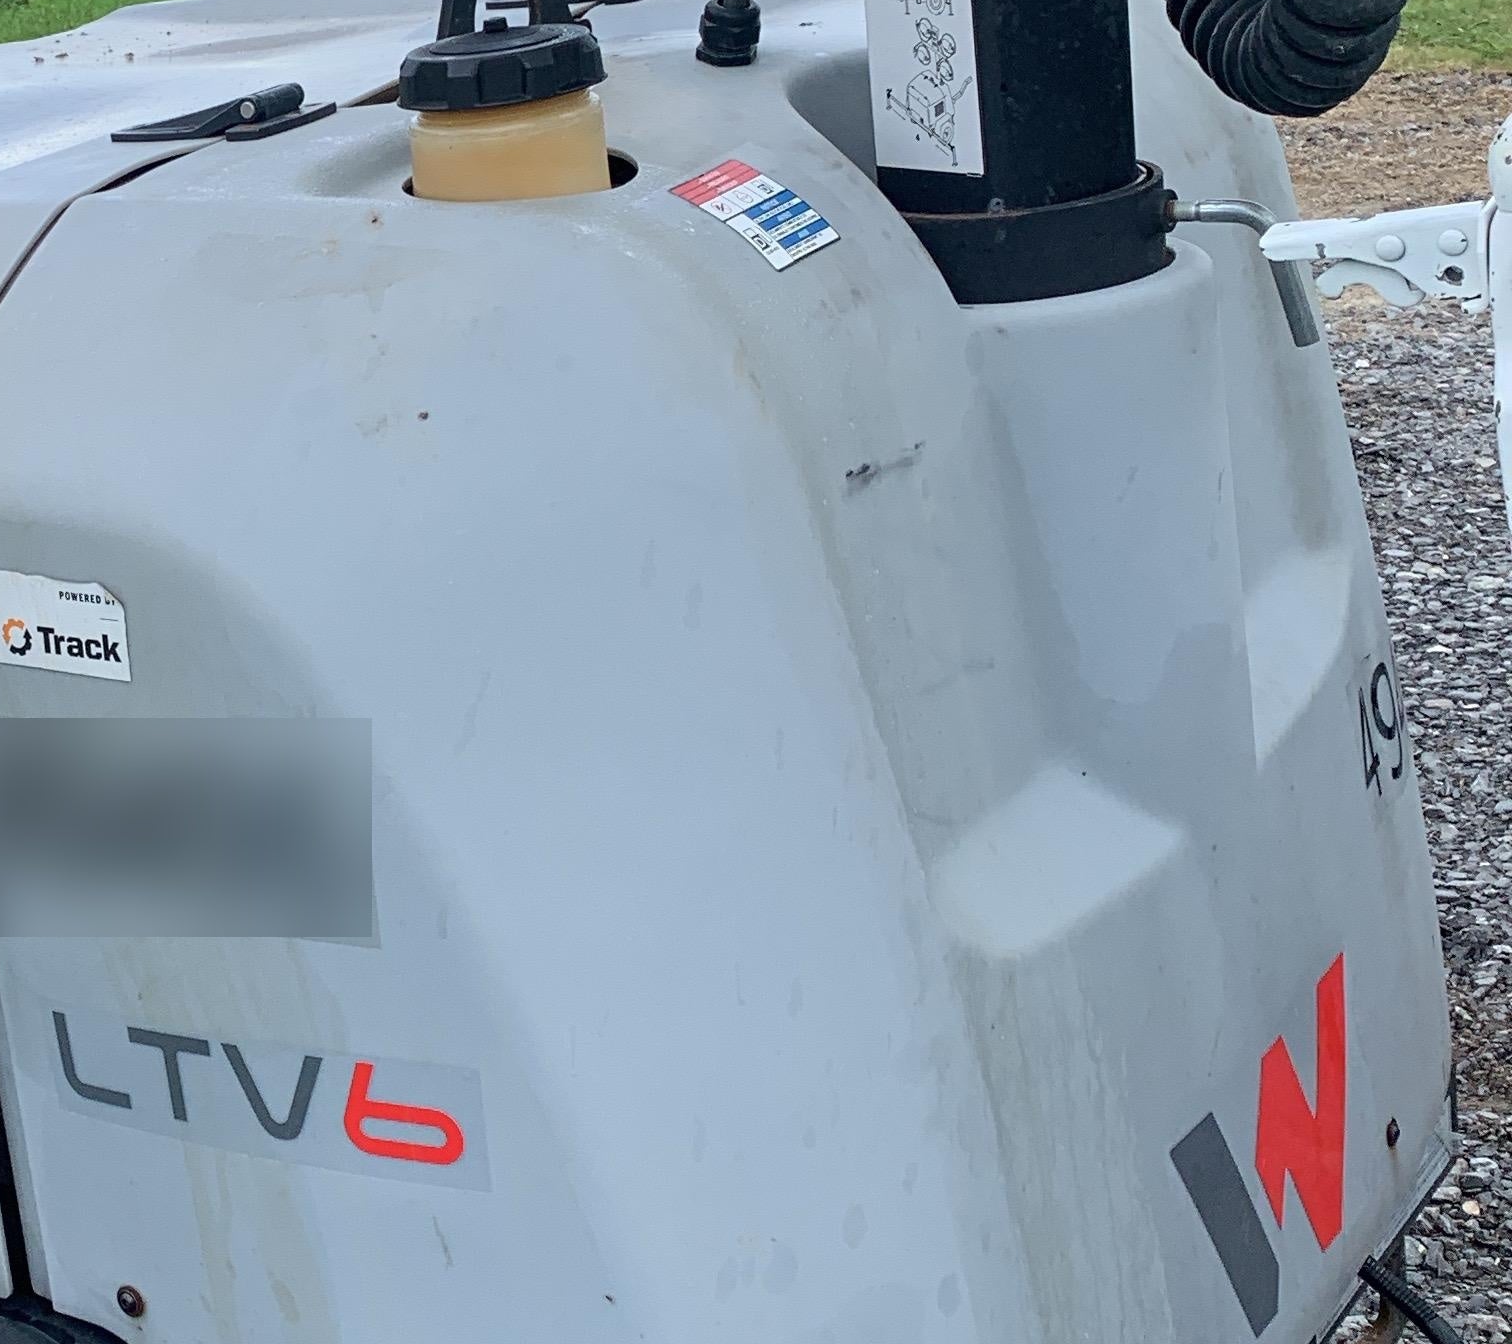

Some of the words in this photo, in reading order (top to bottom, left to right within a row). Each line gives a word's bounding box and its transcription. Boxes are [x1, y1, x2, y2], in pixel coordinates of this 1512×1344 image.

[58, 590, 102, 605] POWERED
[36, 625, 123, 664] Track
[52, 1010, 465, 1166] LTV6
